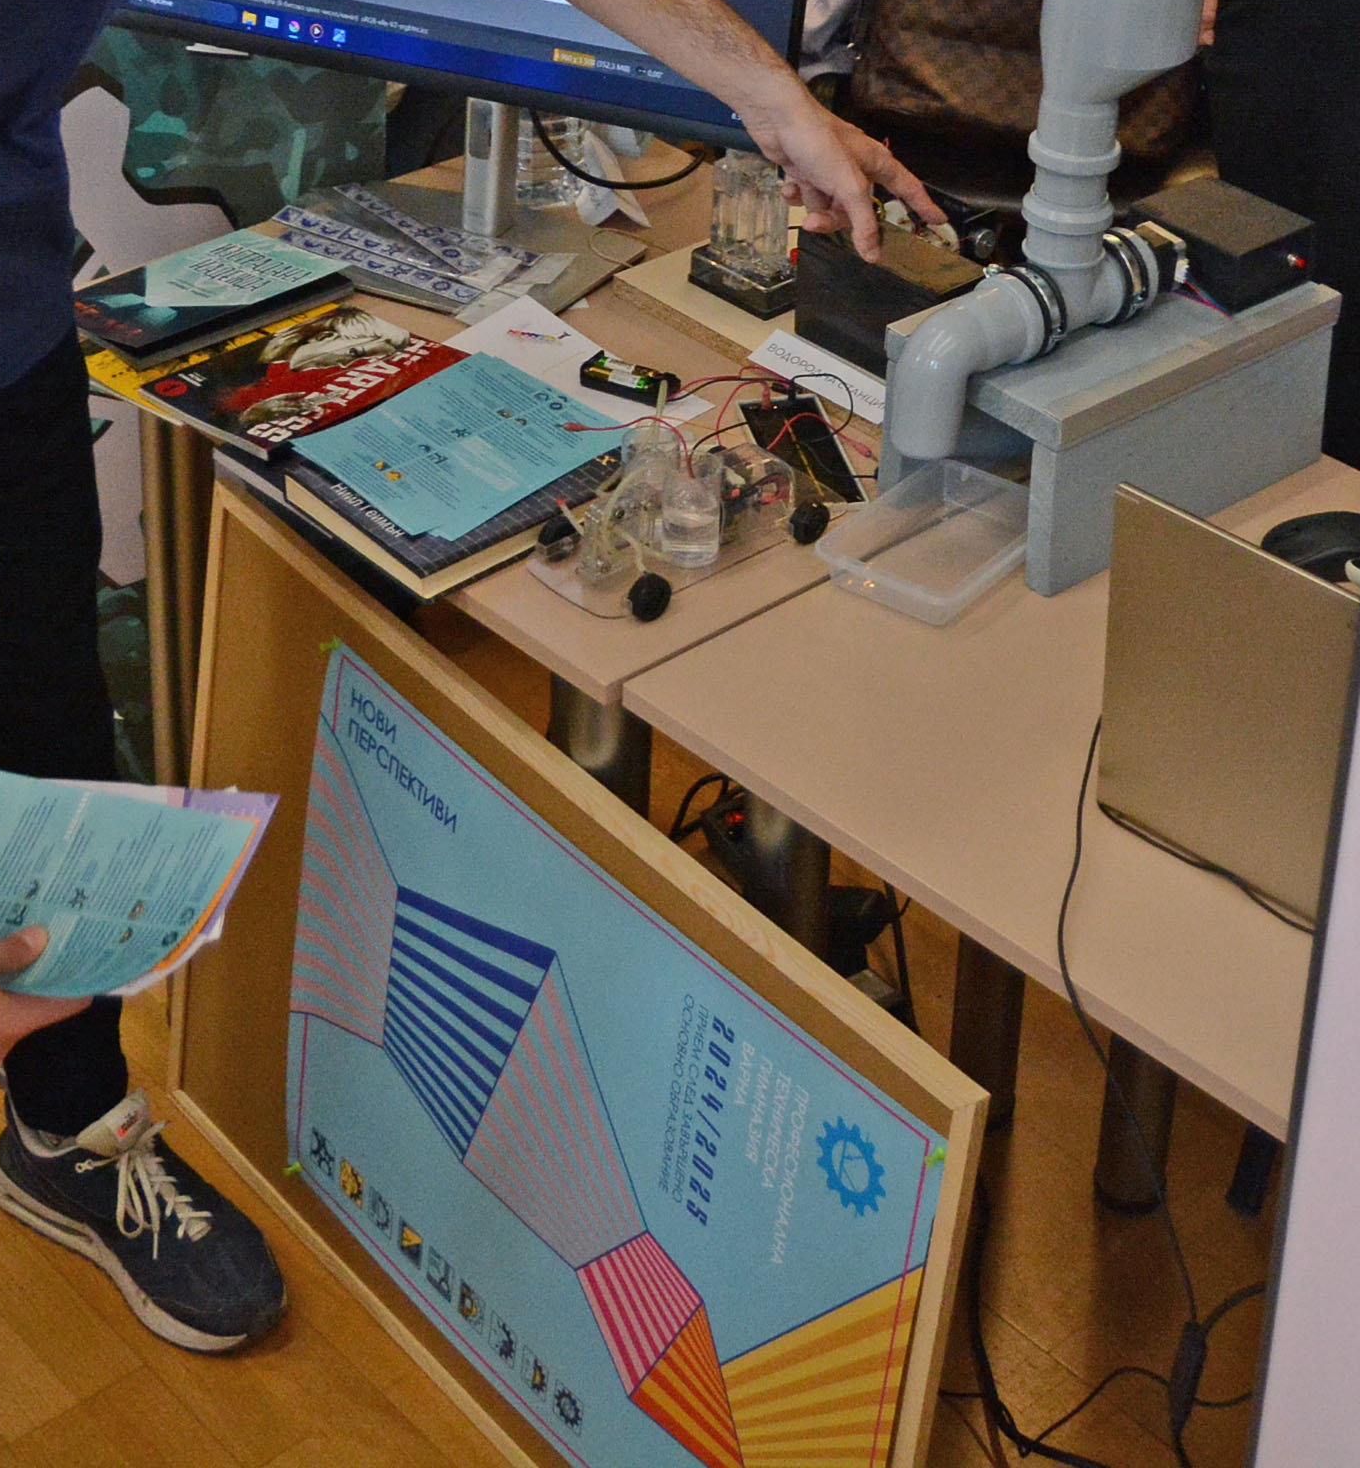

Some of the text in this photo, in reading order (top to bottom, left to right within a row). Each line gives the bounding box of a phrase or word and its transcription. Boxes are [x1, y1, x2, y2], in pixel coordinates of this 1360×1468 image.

[766, 342, 886, 411] ВОДОРОДА СТАНЦИ
[350, 687, 397, 744] НОВИ
[348, 717, 458, 834] ПЕРСПЕКТИВИ
[735, 1041, 756, 1106] ВАРНА
[686, 1016, 736, 1227] 2024/2025
